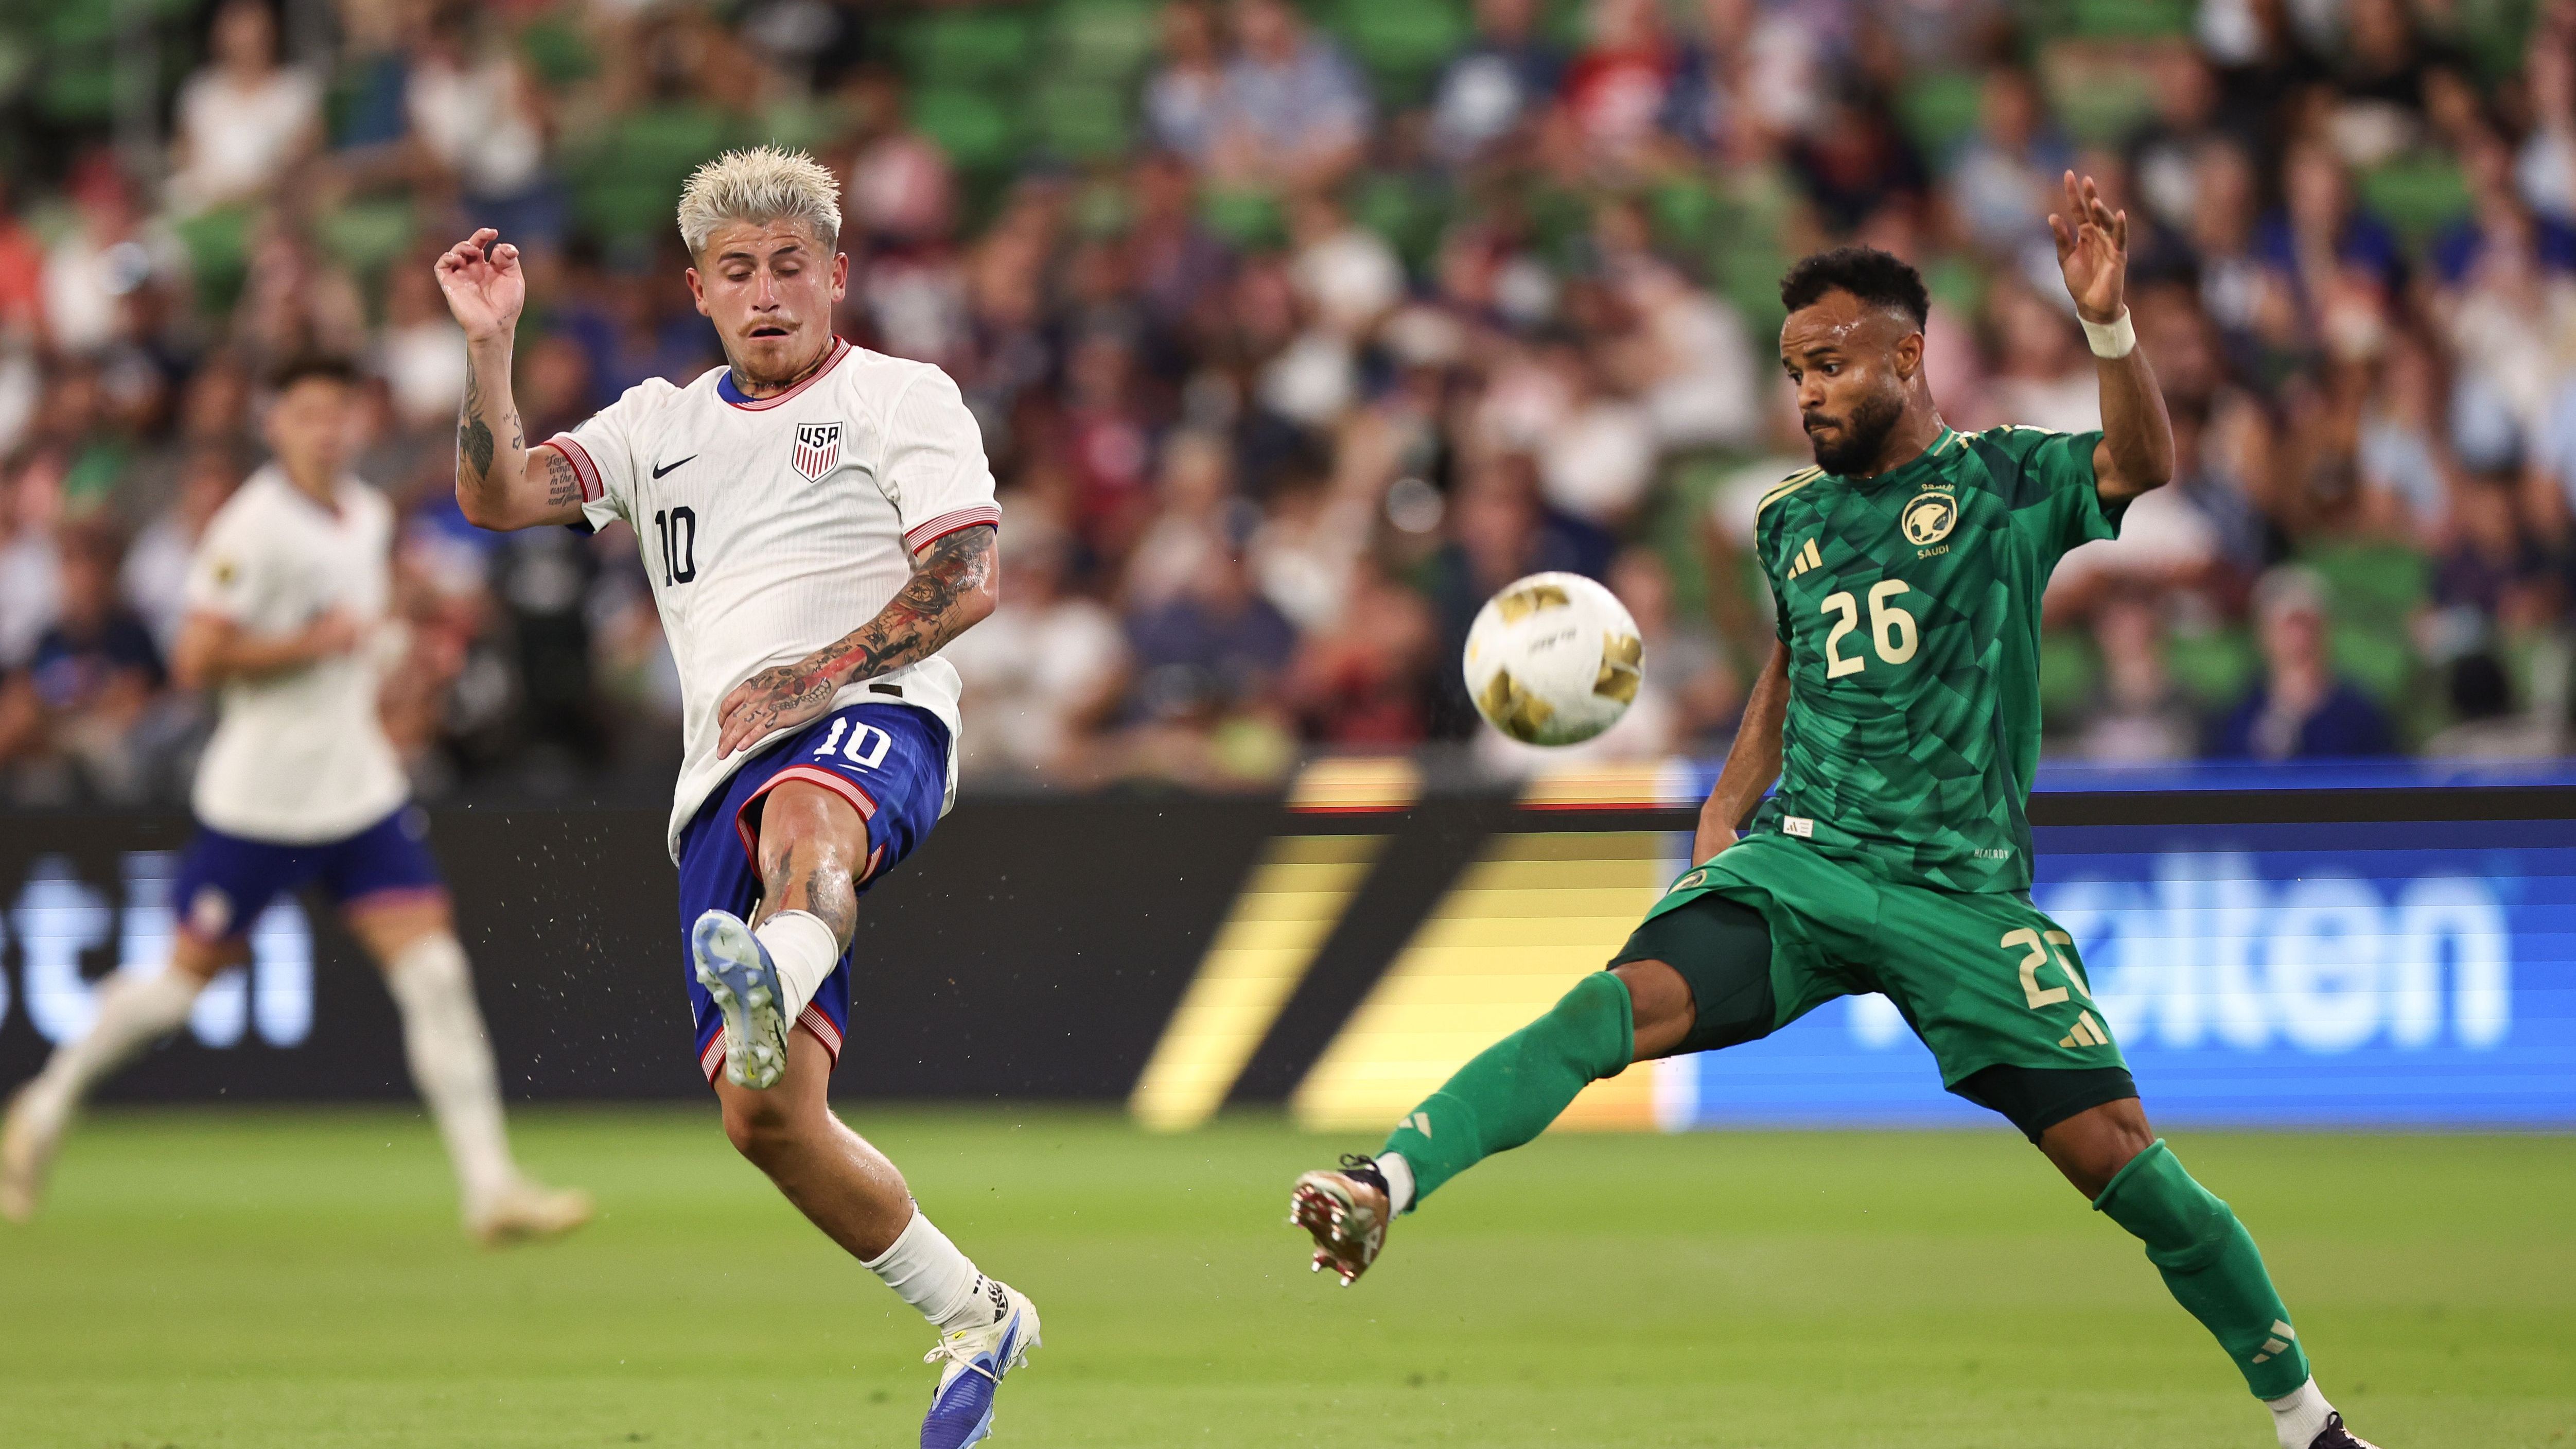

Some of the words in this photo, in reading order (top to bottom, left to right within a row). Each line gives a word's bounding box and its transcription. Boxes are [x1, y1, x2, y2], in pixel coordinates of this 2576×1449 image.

[800, 426, 838, 448] USA
[655, 506, 696, 587] 10
[1917, 544, 1949, 560] SAUDI
[1820, 578, 1918, 679] 26
[813, 716, 892, 770] 10
[1847, 849, 2513, 1052] olten
